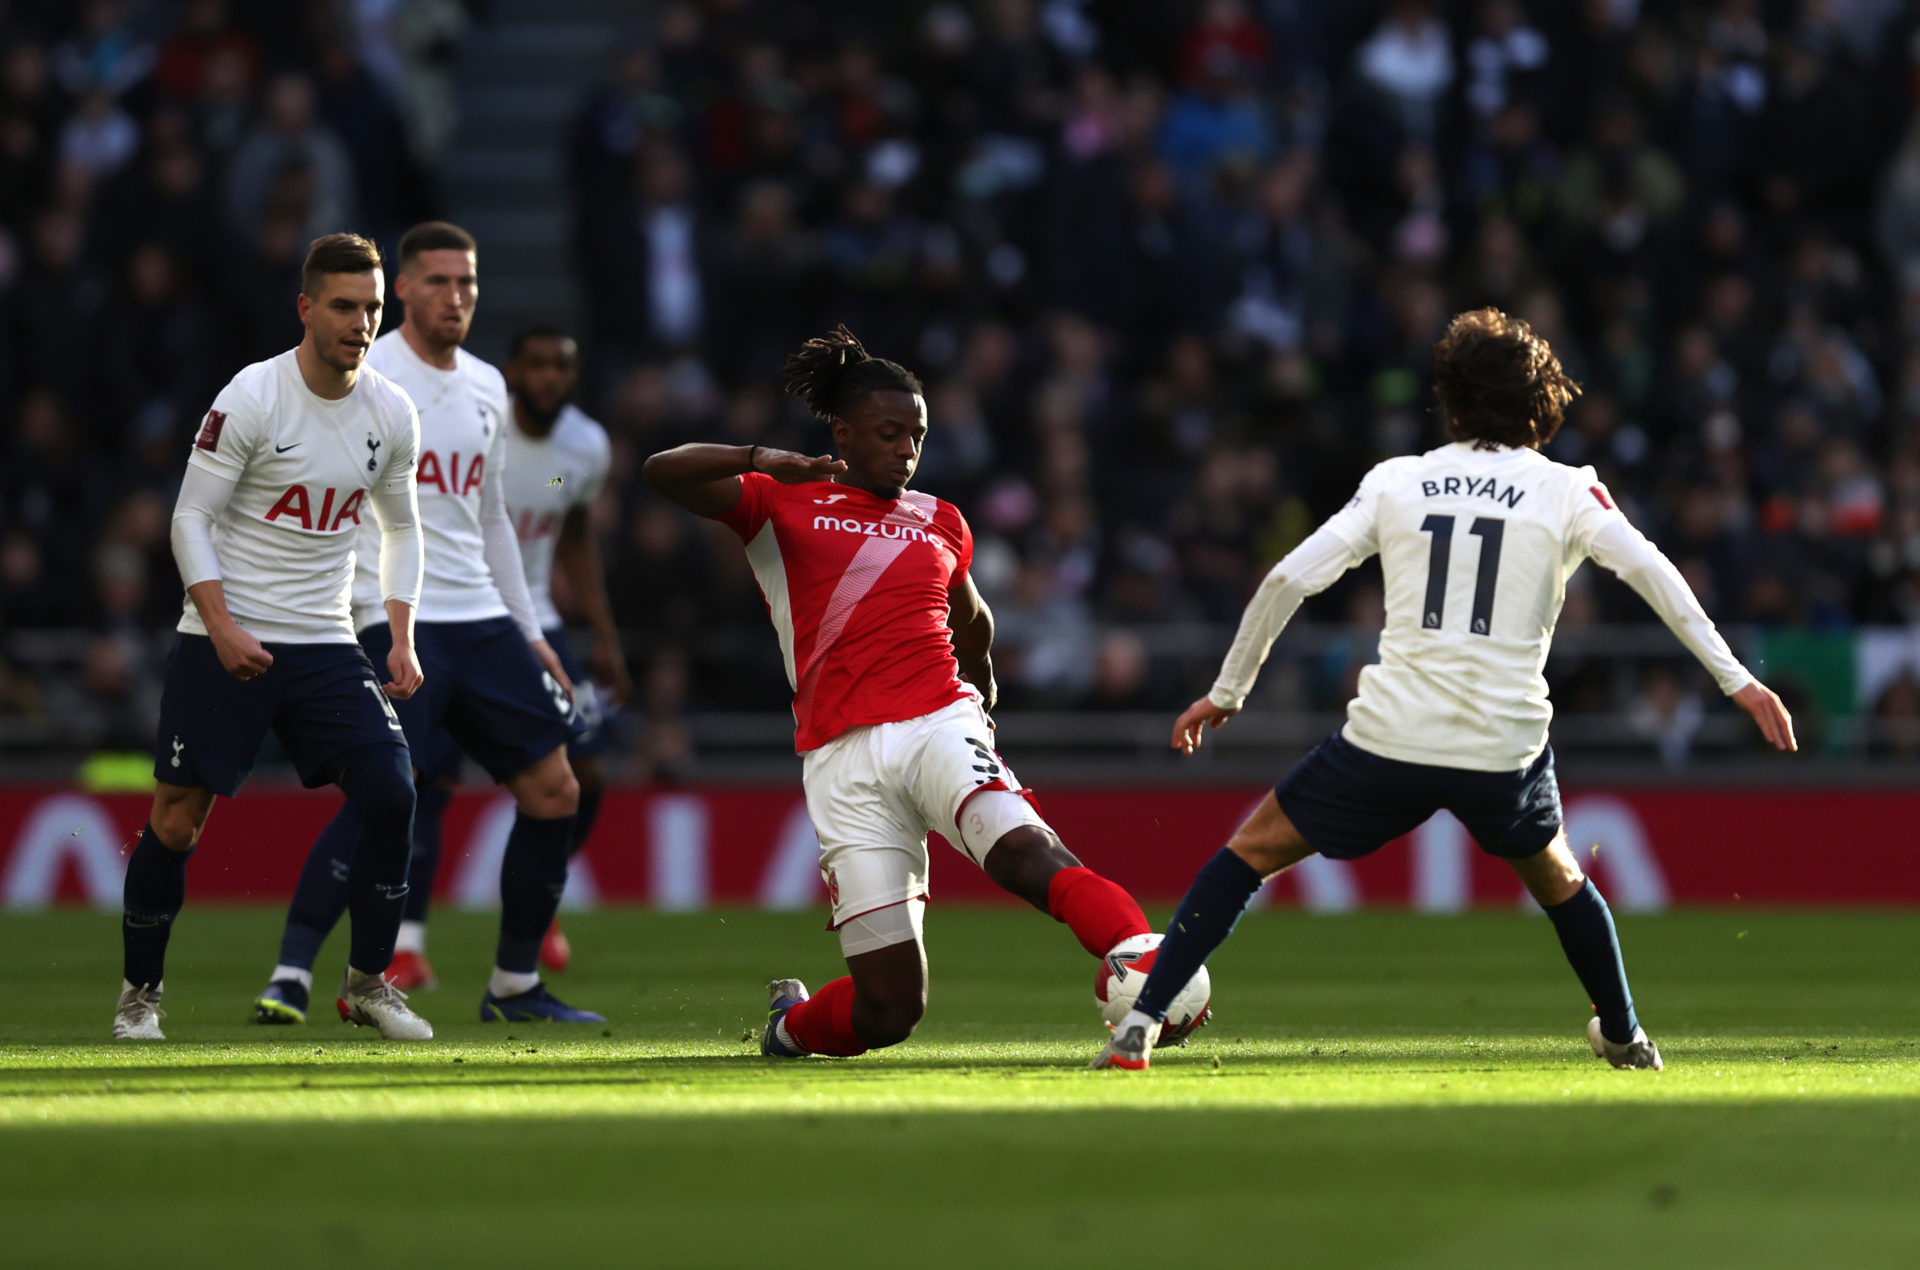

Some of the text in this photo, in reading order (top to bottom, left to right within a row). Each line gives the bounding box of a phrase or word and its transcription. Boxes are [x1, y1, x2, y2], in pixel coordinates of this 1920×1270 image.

[416, 449, 484, 496] AIA
[1421, 476, 1525, 509] BRYAN
[264, 484, 365, 531] AIA
[813, 515, 944, 550] mazuma
[1420, 513, 1506, 636] 11
[970, 812, 985, 836] 3
